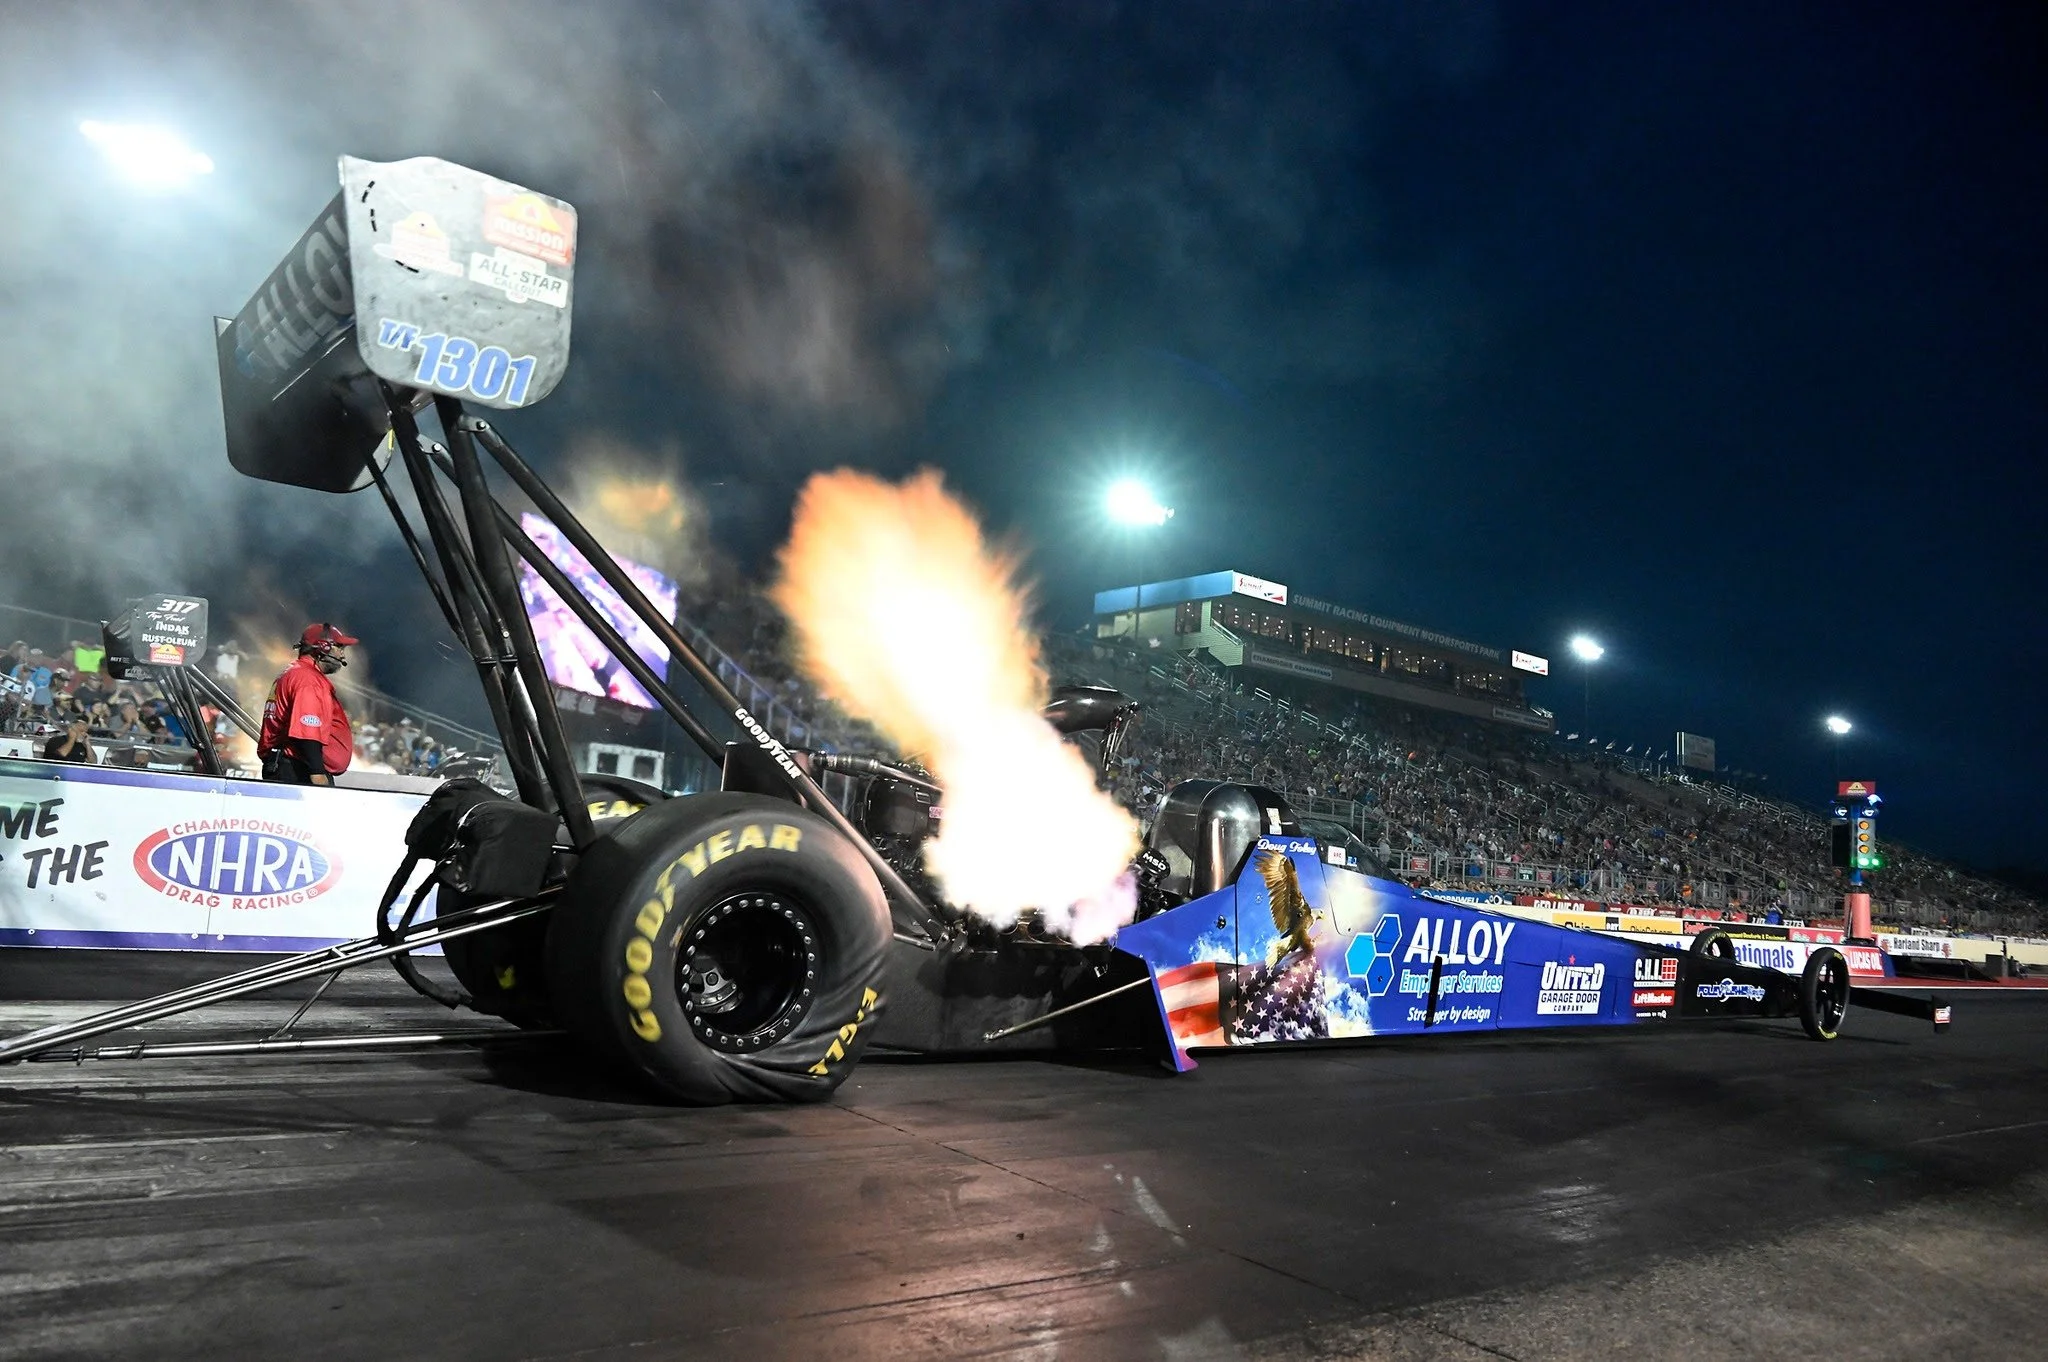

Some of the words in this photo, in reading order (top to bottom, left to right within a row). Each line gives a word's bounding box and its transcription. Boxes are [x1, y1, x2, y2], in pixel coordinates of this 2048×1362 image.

[479, 258, 562, 293] ALL-STAR
[414, 332, 537, 406] 1301
[157, 599, 200, 613] 317
[1293, 594, 1331, 613] SUMMIT
[1333, 605, 1368, 624] RACING
[1369, 615, 1420, 637] EQUIPMENT
[1421, 629, 1479, 653] MOTORSPORTS
[1480, 645, 1500, 661] PARK
[142, 634, 197, 647] RUST-OLEUM
[735, 708, 801, 779] GOODYEAR
[173, 818, 313, 842] CHAMPIONSHIP
[1257, 839, 1287, 853] Doug
[1289, 841, 1316, 856] Foley
[23, 840, 109, 889] THE
[168, 833, 315, 893] NHRA
[1142, 852, 1166, 871] MSD
[166, 884, 220, 908] DRAG
[232, 891, 304, 910] RACING
[623, 824, 802, 1042] GOODYEAR
[1403, 917, 1515, 966] ALLOY
[1893, 937, 1920, 951] Harland
[1921, 938, 1940, 952] Sharp
[1735, 943, 1794, 969] ationals
[1850, 950, 1870, 969] LUCAS
[1870, 952, 1882, 970] OIL
[1541, 961, 1605, 991] UNITED
[1635, 958, 1661, 981] C.H.I.
[1399, 969, 1458, 1000] Emplyer
[1456, 969, 1503, 994] Services
[1541, 993, 1573, 1003] GARAGE
[1576, 993, 1598, 1003] DOOR
[1553, 1004, 1583, 1012] COMPANY
[1633, 992, 1673, 1005] LiftMaster
[1407, 1006, 1448, 1024] Stroger
[1449, 1006, 1461, 1024] by
[1461, 1005, 1490, 1023] design
